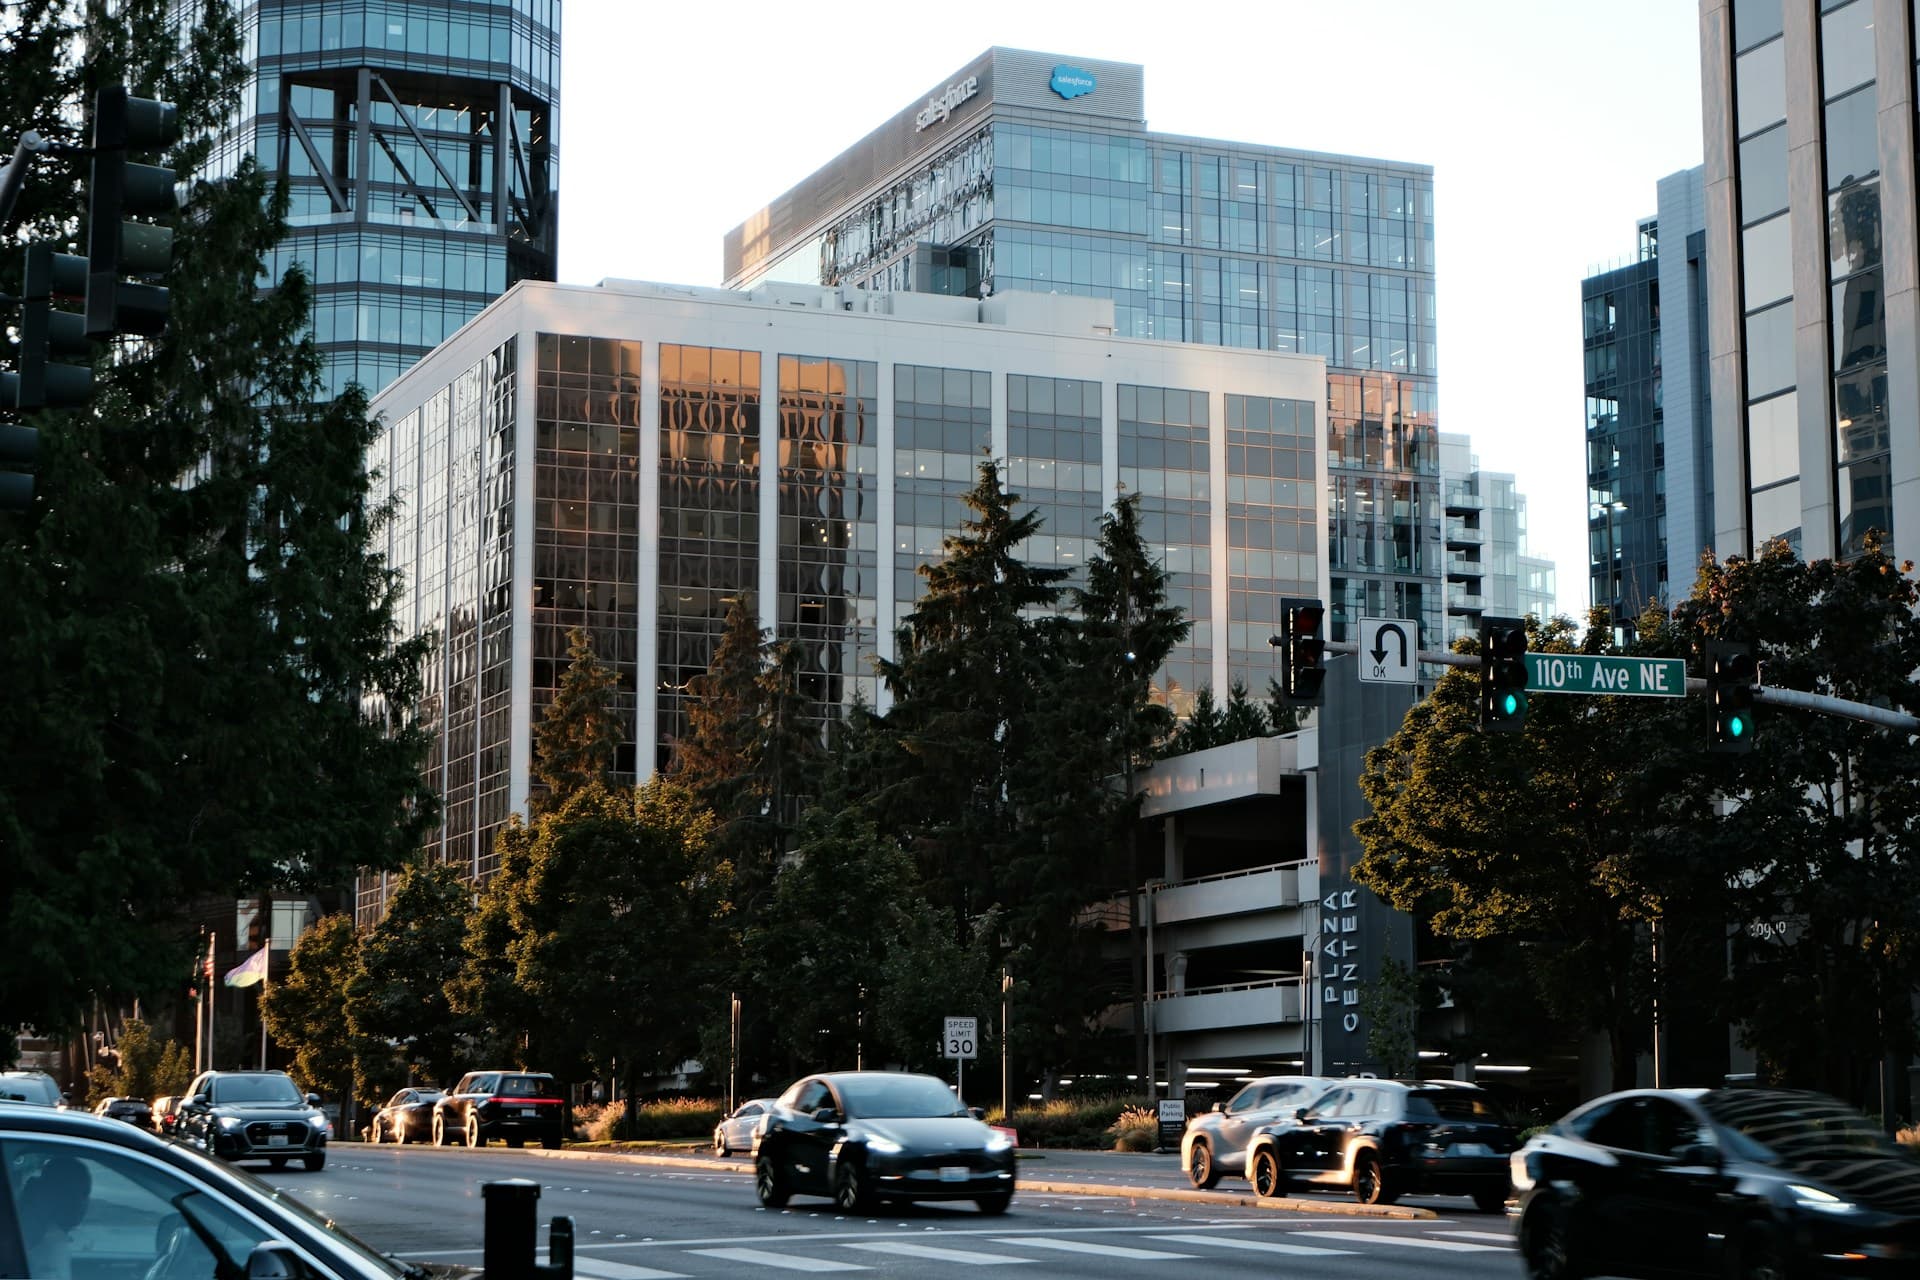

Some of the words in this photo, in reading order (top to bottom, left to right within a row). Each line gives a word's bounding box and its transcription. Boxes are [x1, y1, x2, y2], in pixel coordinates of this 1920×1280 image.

[1057, 75, 1093, 88] salesforce
[915, 76, 978, 133] salesforce
[1373, 665, 1386, 678] OK
[1536, 658, 1582, 688] 110th
[1592, 662, 1629, 690] Ave
[1639, 663, 1668, 691] NE
[1323, 891, 1339, 1003] PLAZA
[1342, 888, 1359, 1032] CENTER
[950, 1040, 973, 1054] 30
